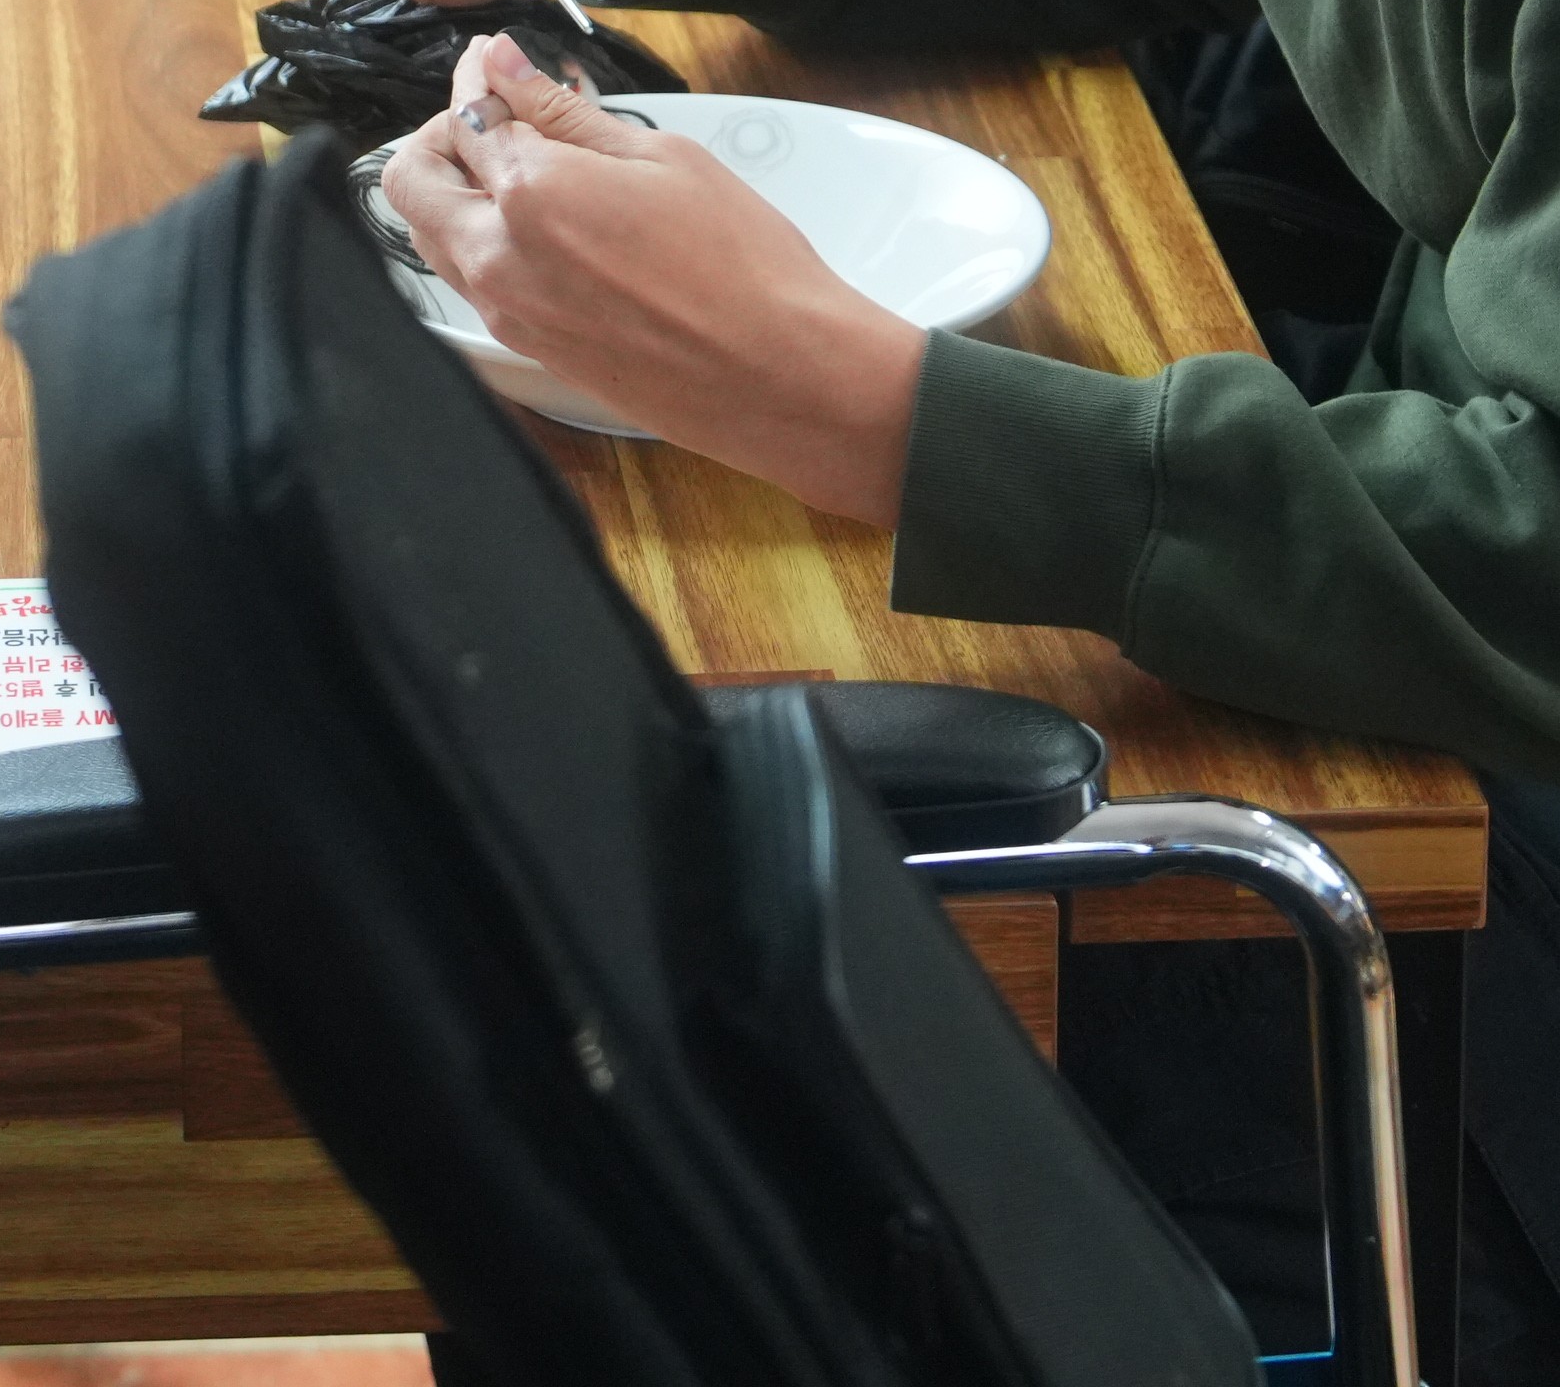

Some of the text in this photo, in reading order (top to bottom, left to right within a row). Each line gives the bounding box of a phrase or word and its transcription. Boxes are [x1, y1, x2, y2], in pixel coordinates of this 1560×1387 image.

[2, 655, 51, 674] 리뷰
[60, 654, 88, 674] 한
[53, 679, 79, 698] 후
